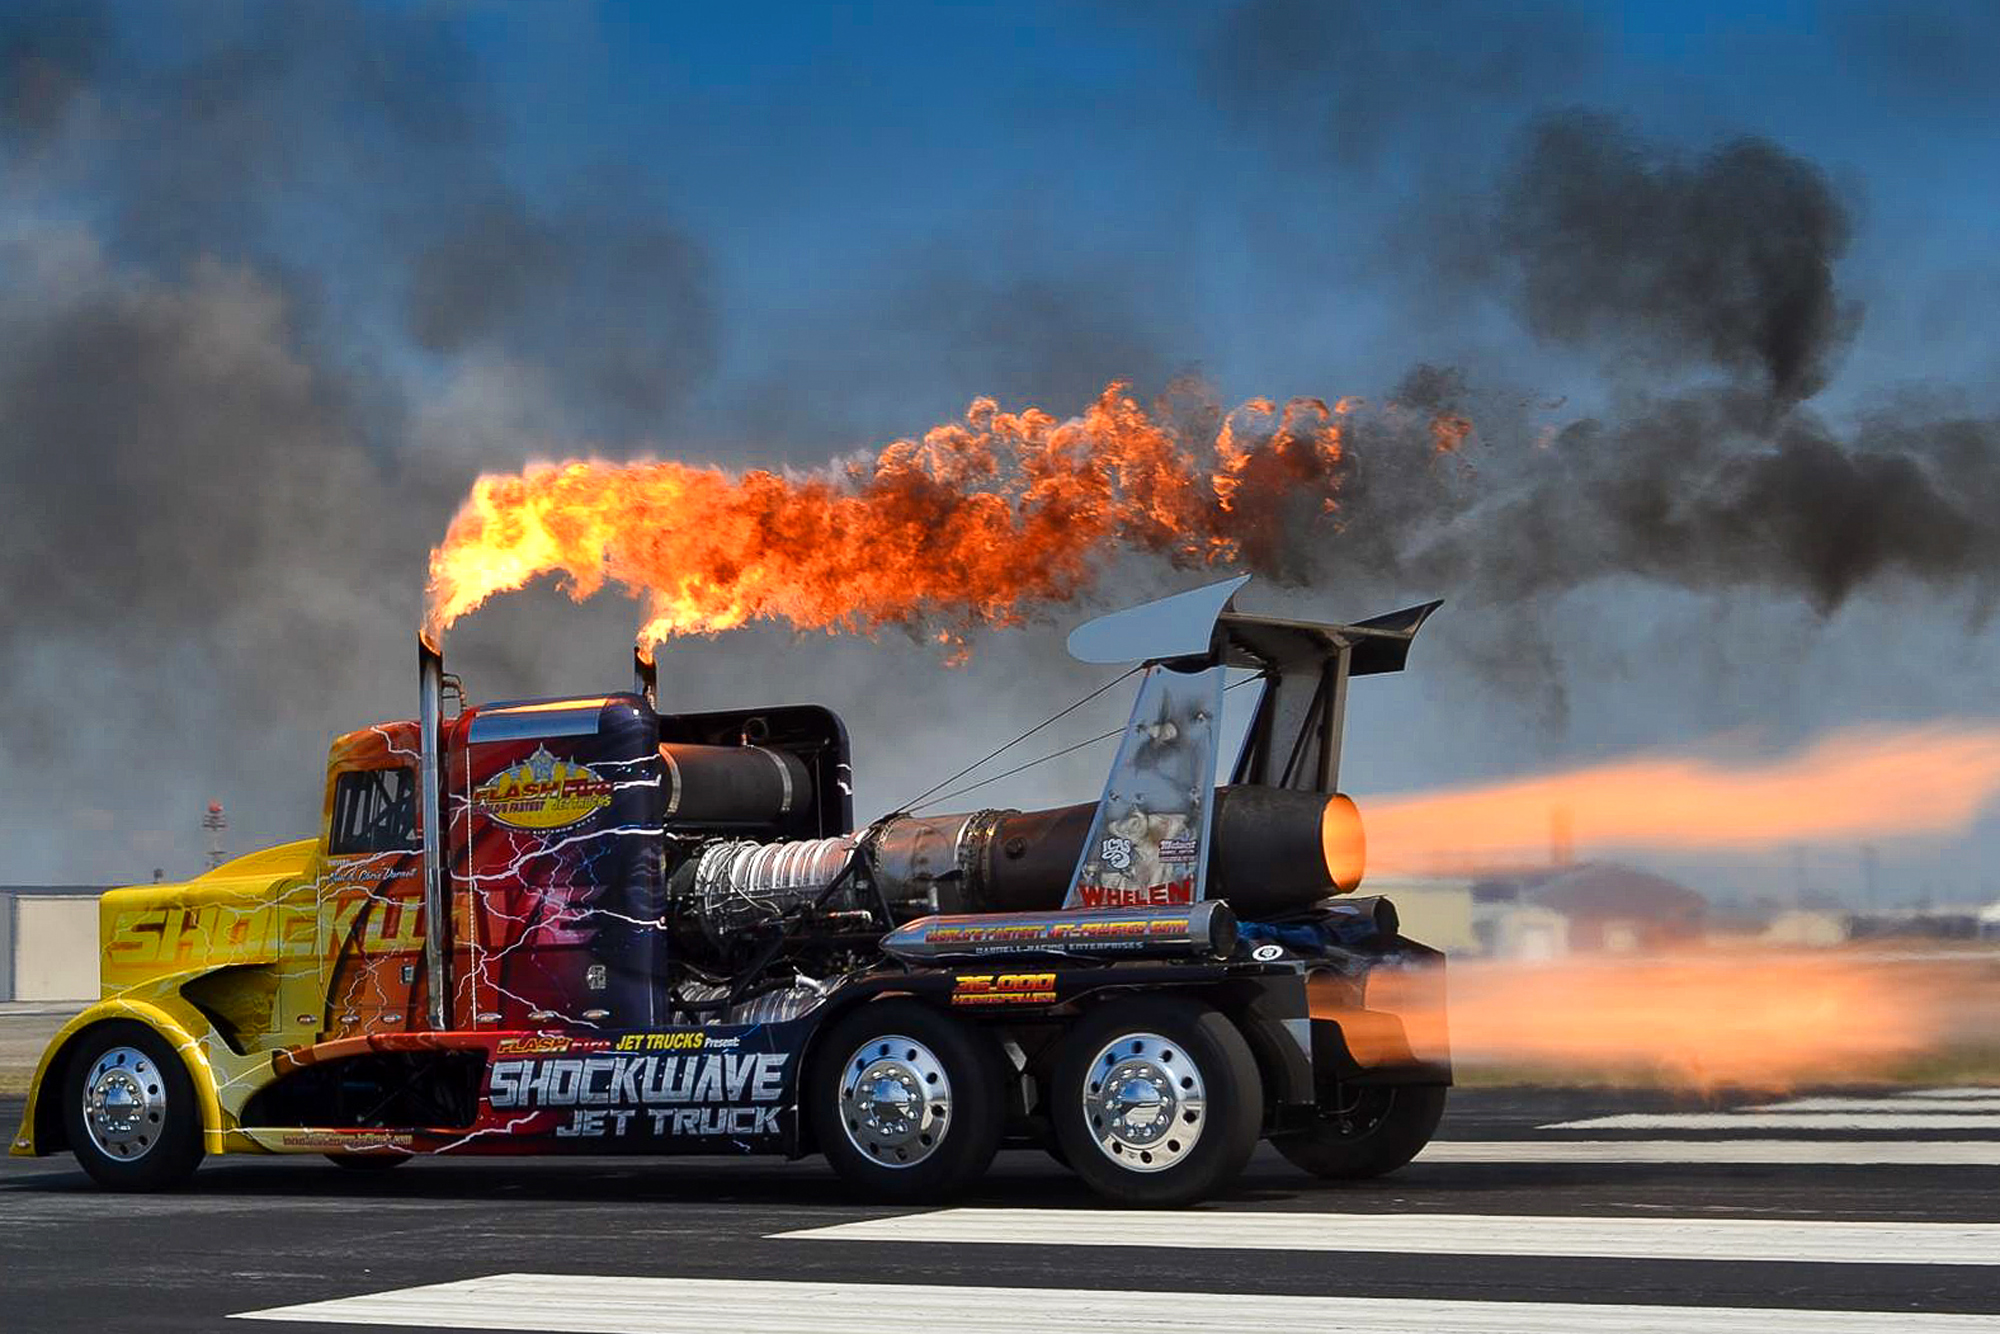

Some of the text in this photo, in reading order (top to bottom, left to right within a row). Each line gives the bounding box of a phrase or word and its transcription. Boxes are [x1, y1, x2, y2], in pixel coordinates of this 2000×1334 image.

[473, 781, 561, 801] FLASH
[568, 794, 612, 810] TRUCKS
[1079, 878, 1193, 906] WHELEN
[980, 925, 1046, 940] FASTEST
[1068, 941, 1144, 951] ENTERPRISES
[497, 1037, 571, 1054] FLASH
[616, 1035, 643, 1050] JET
[646, 1033, 703, 1050] TRUCKS
[704, 1036, 740, 1049] Present:
[490, 1053, 788, 1107] SHOCKWAVE
[556, 1106, 783, 1137] JET TRUCK
